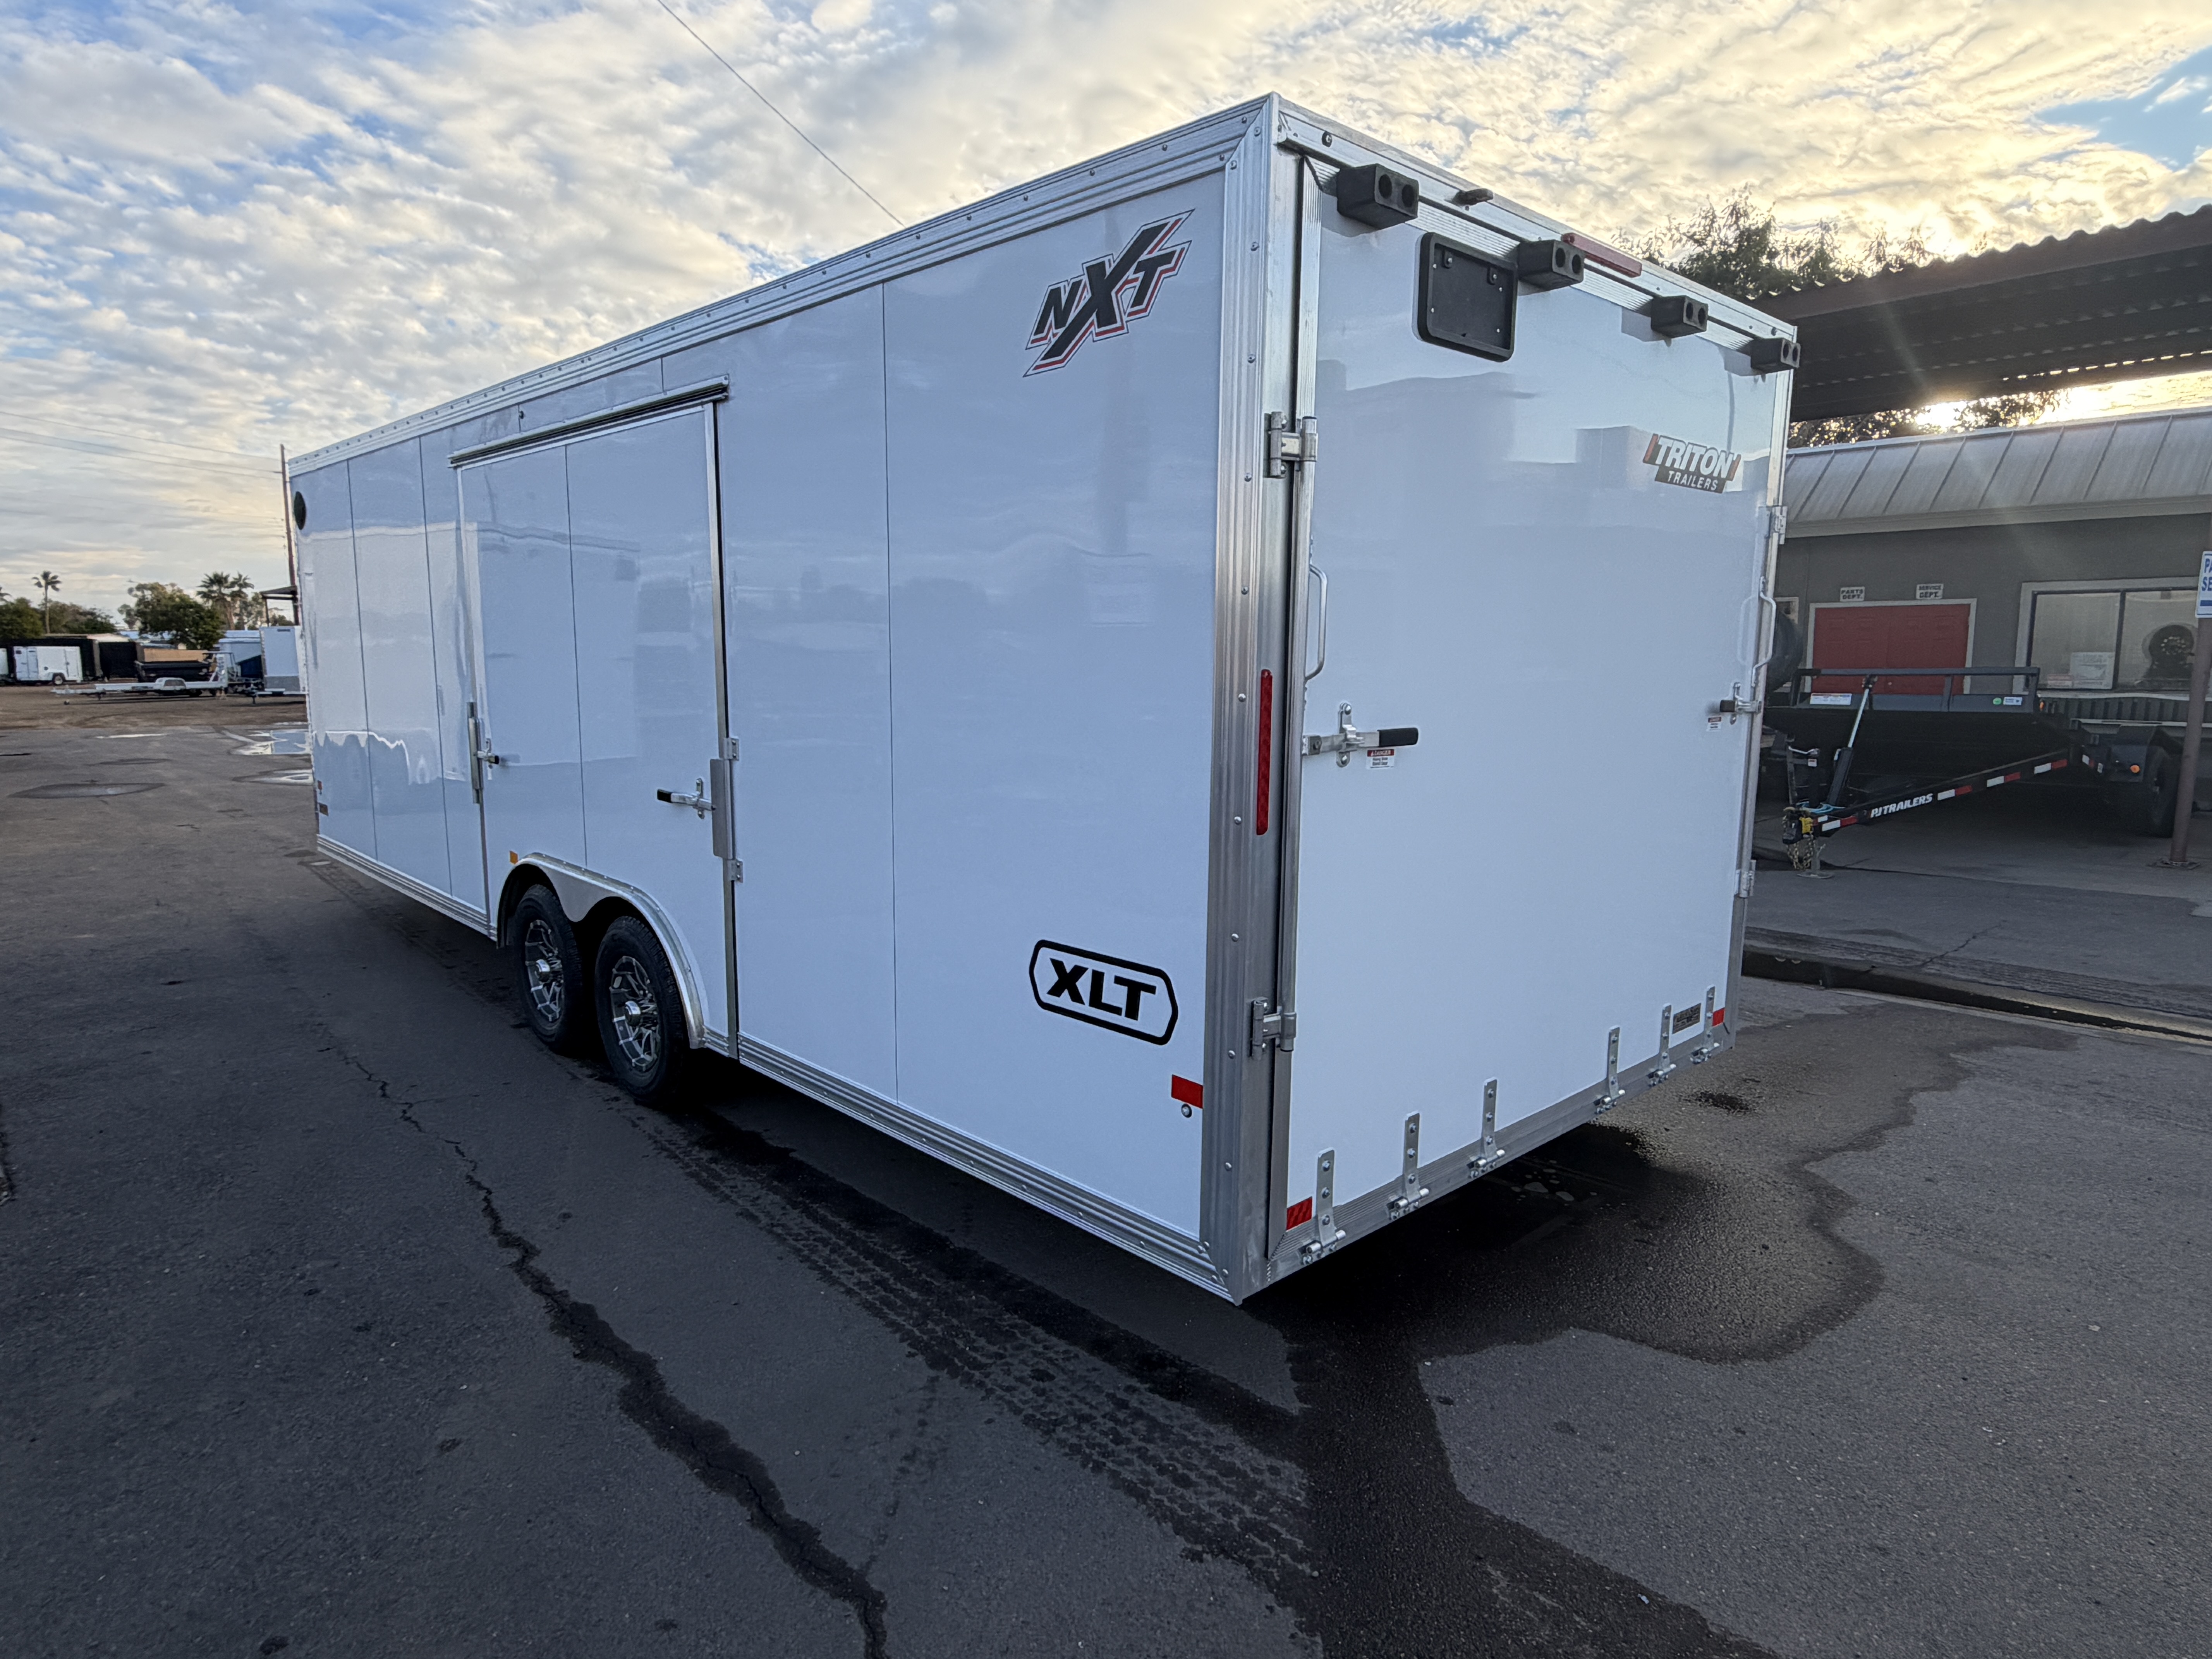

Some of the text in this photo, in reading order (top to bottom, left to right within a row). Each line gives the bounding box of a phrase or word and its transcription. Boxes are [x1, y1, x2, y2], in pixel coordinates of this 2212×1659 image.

[1023, 209, 1195, 377] NXT
[1655, 435, 1734, 479] TRITON
[1668, 471, 1718, 491] TRAILERS
[1883, 793, 1933, 814] TRAILERS
[1046, 957, 1157, 1021] XLT
